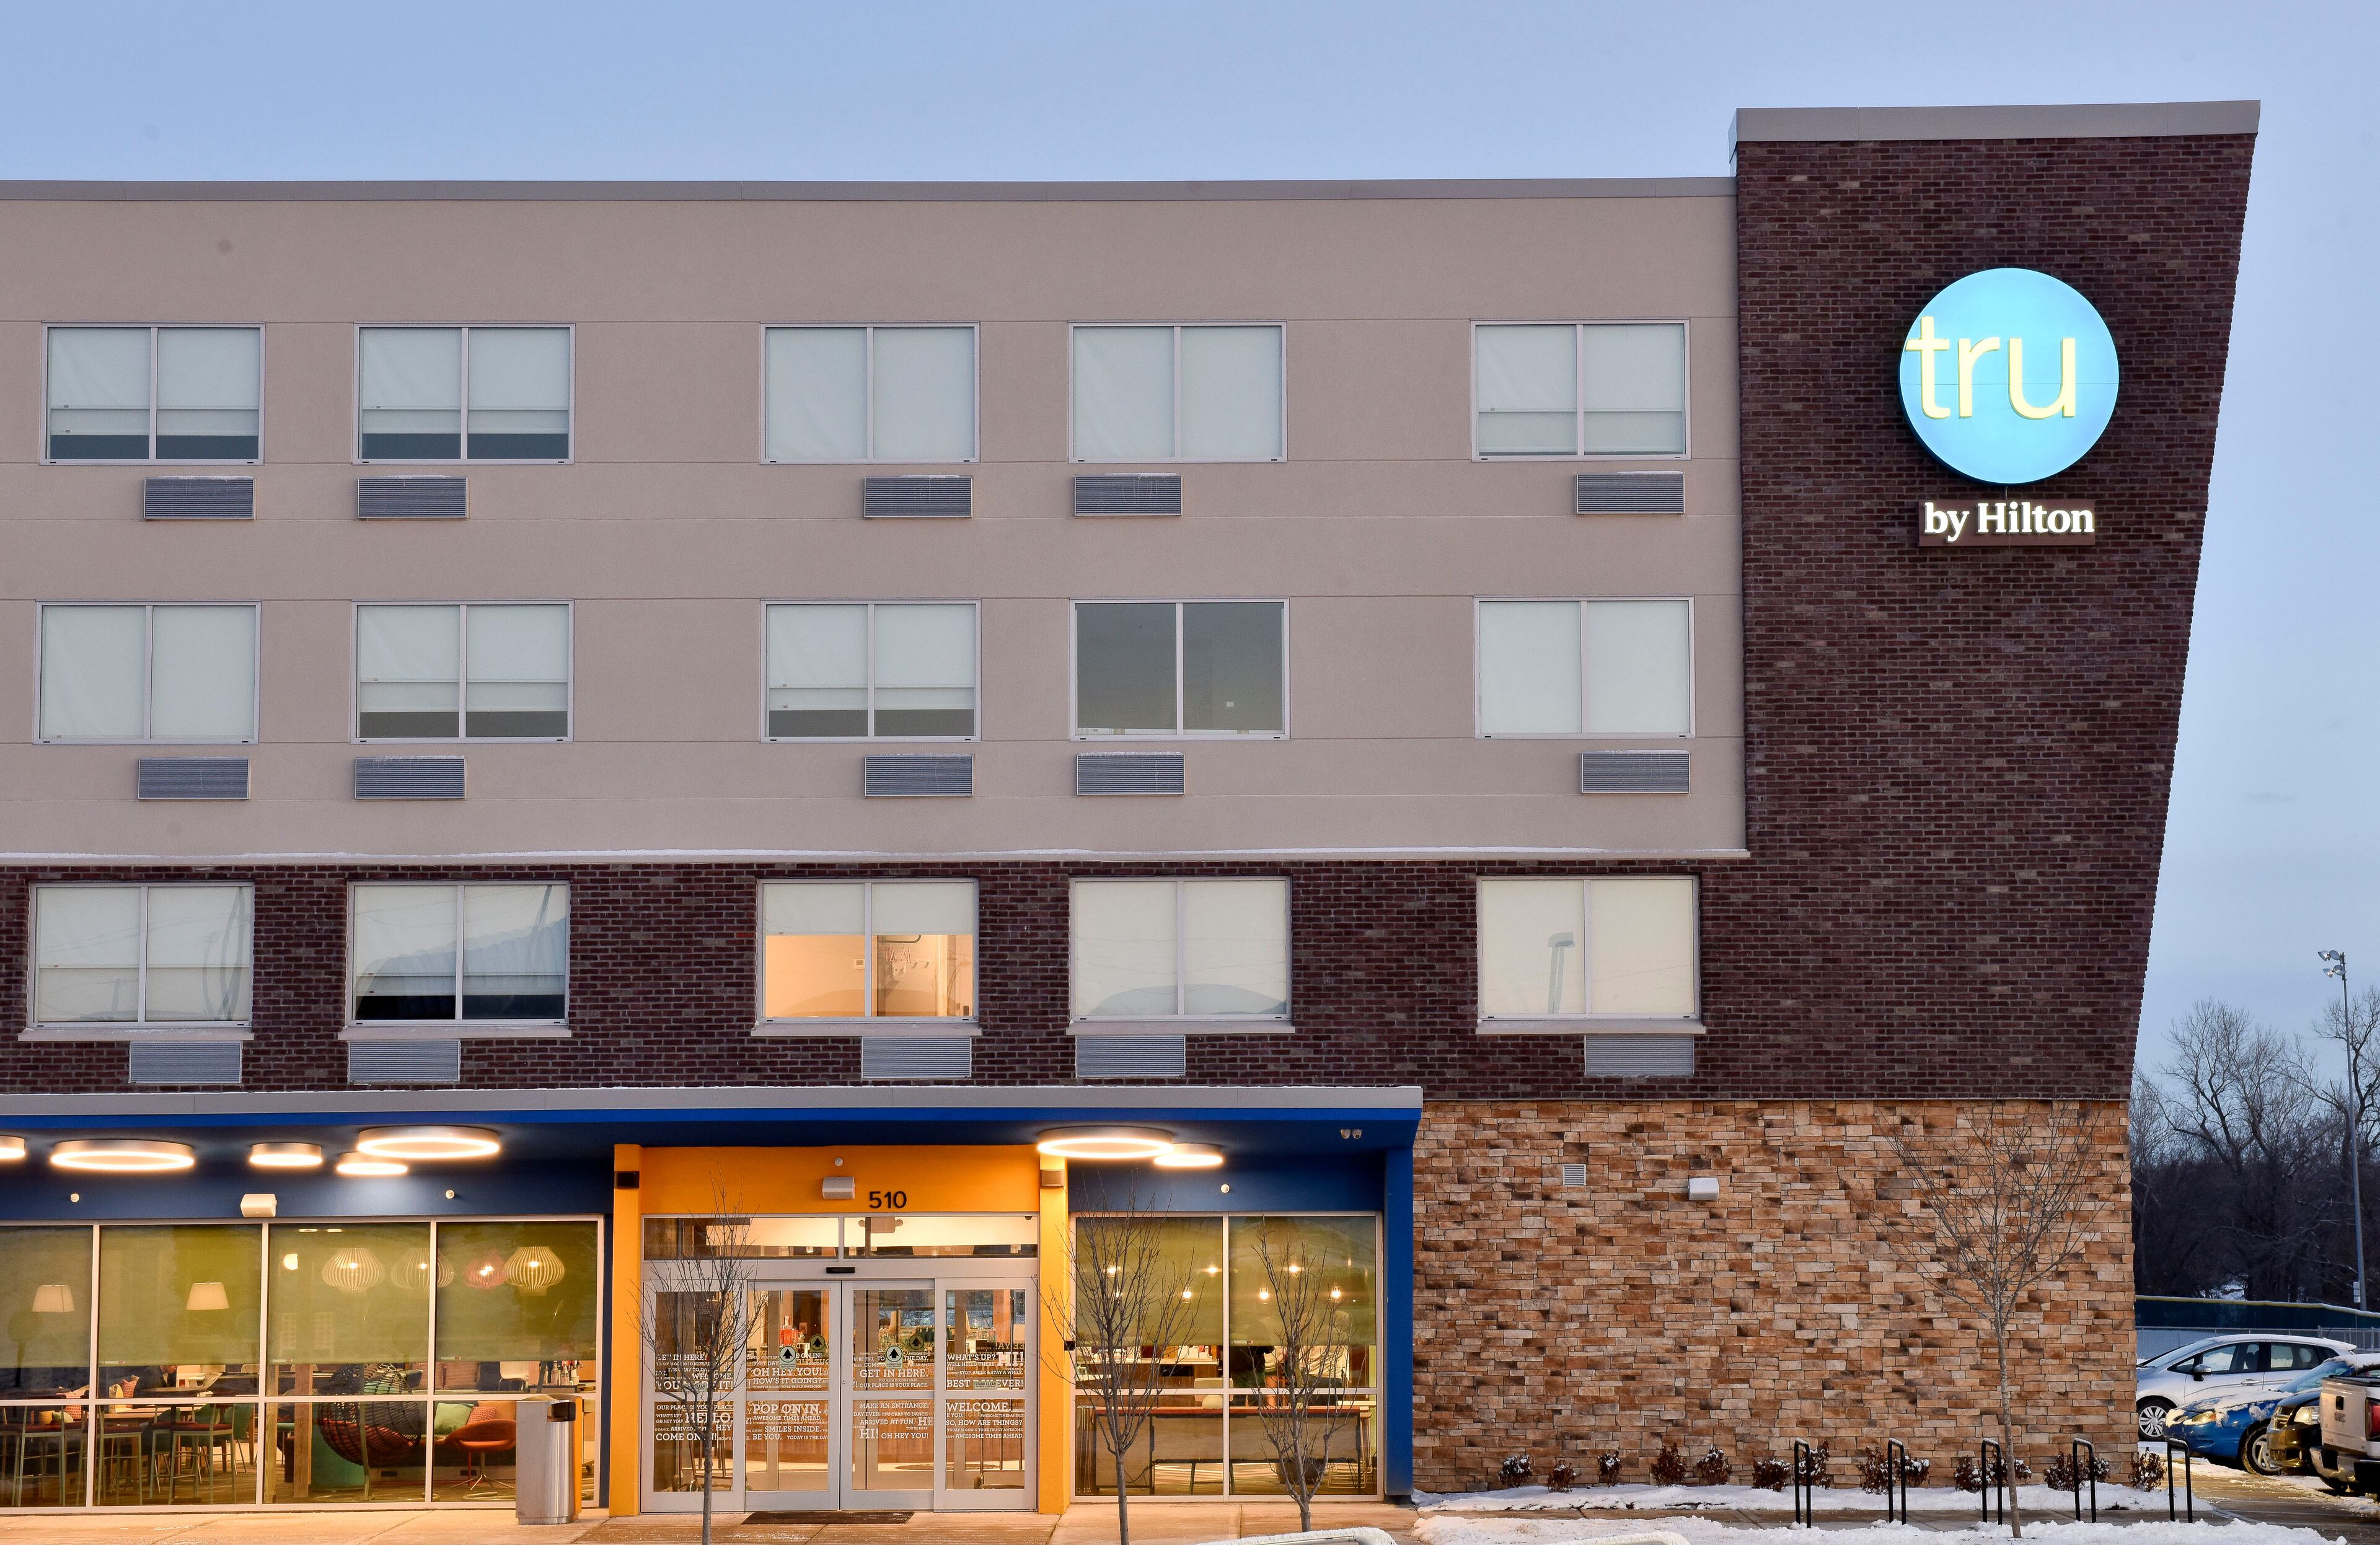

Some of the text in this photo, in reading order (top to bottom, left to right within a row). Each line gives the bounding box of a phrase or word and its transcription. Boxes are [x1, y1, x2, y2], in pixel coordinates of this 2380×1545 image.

[1905, 315, 2076, 420] tru
[1924, 501, 2095, 543] by Hilton
[869, 1191, 907, 1208] 510
[997, 1352, 1024, 1367] HI!
[753, 1368, 769, 1376] OH
[772, 1368, 794, 1376] HEY
[796, 1368, 822, 1376] YOU!
[860, 1369, 928, 1378] GET IN HERE.
[753, 1404, 779, 1414] POP
[782, 1404, 801, 1414] ON
[946, 1402, 1008, 1412] WELCOME.
[656, 1433, 684, 1441] COME
[860, 1428, 879, 1438] HI!
